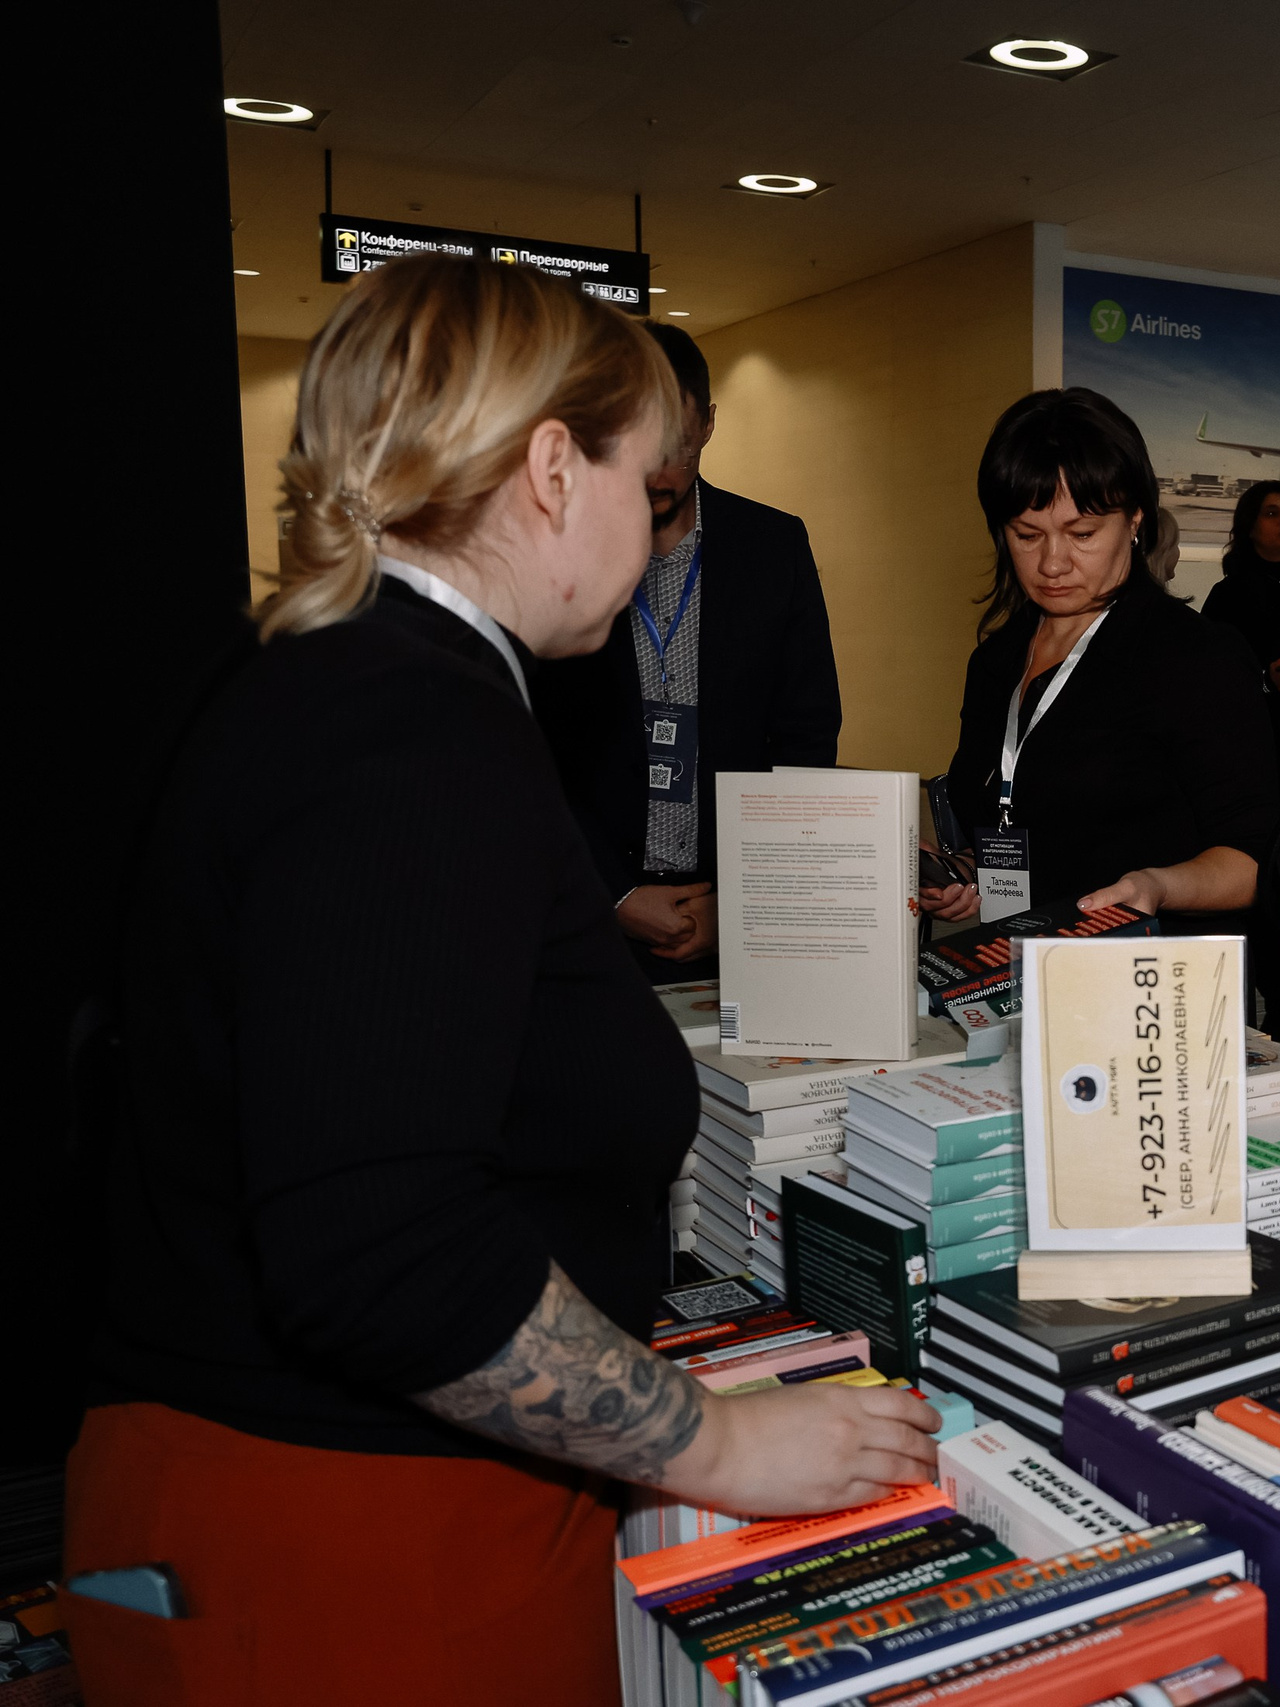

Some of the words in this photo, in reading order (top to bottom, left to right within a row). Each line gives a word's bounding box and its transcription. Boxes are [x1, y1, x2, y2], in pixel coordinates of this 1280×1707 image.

[361, 231, 473, 256] Конференц-залы
[361, 245, 404, 256] Conference
[520, 250, 610, 272] Переговорные
[1096, 309, 1120, 333] S7
[1131, 313, 1202, 340] Airlines
[983, 855, 1023, 867] СТАНДАРТ
[986, 885, 1024, 898] Тимофеева
[991, 876, 1018, 888] Татьяна
[1172, 961, 1188, 978] Я)
[940, 980, 982, 999] вызовы
[942, 977, 1017, 1009] подчиненные:
[1174, 981, 1189, 1101] НИКОЛАЕВНА
[1134, 956, 1164, 1220] +7-923-116-52-81
[1177, 1106, 1191, 1154] АННА
[1173, 1159, 1195, 1210] (СБЕР,
[1007, 1464, 1077, 1518] ПРИВЕСТИ
[1019, 1453, 1083, 1501] ПОРЯДОК
[1073, 1512, 1105, 1537] КАК
[800, 1550, 971, 1614] ПРОДУКТИВНОСТЬ
[844, 1567, 946, 1610] ЗДОРОВАЯ
